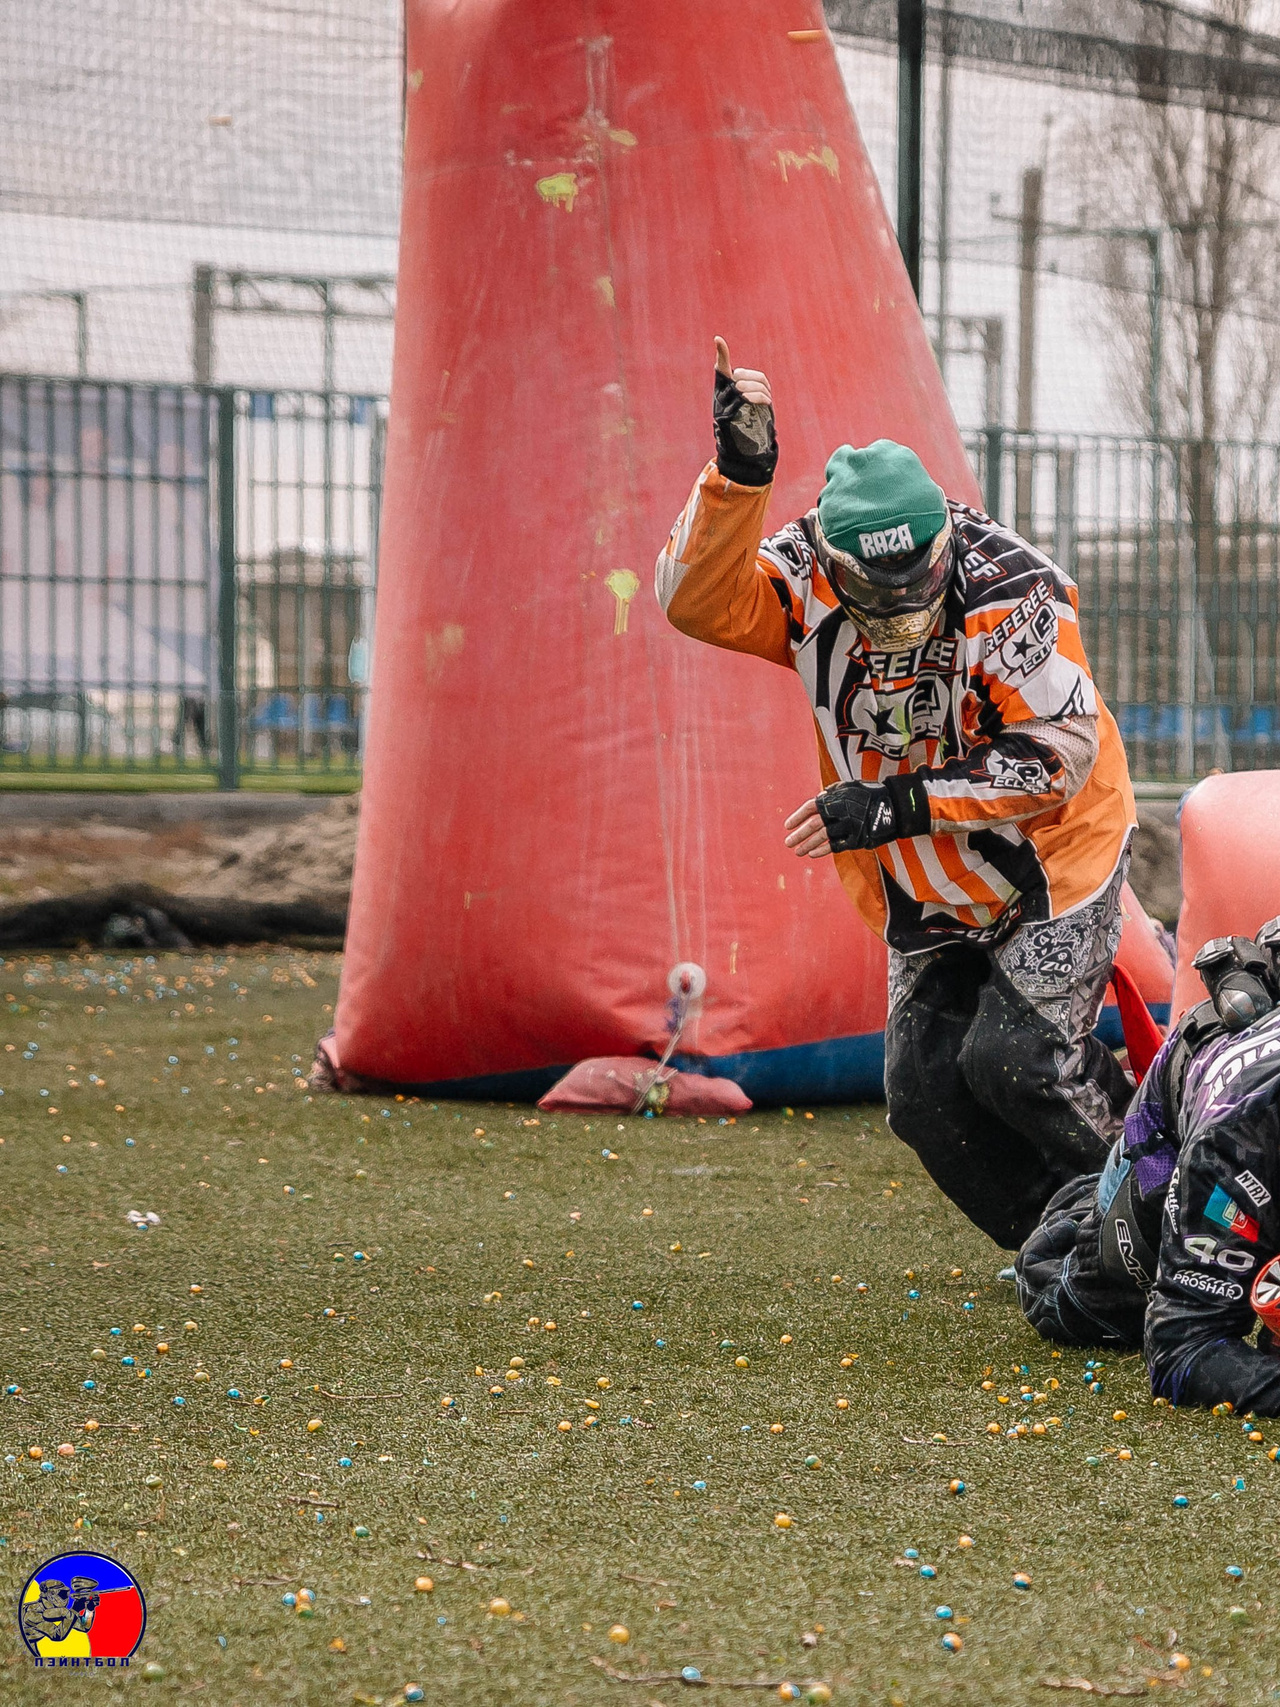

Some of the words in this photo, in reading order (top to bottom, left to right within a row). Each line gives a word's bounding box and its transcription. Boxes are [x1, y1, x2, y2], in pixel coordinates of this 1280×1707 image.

[985, 580, 1050, 657] REFEREE
[1238, 1172, 1270, 1204] NTRX
[1114, 1218, 1156, 1303] EMPI
[1183, 1236, 1256, 1273] 40
[1172, 1270, 1241, 1300] PROSHAR
